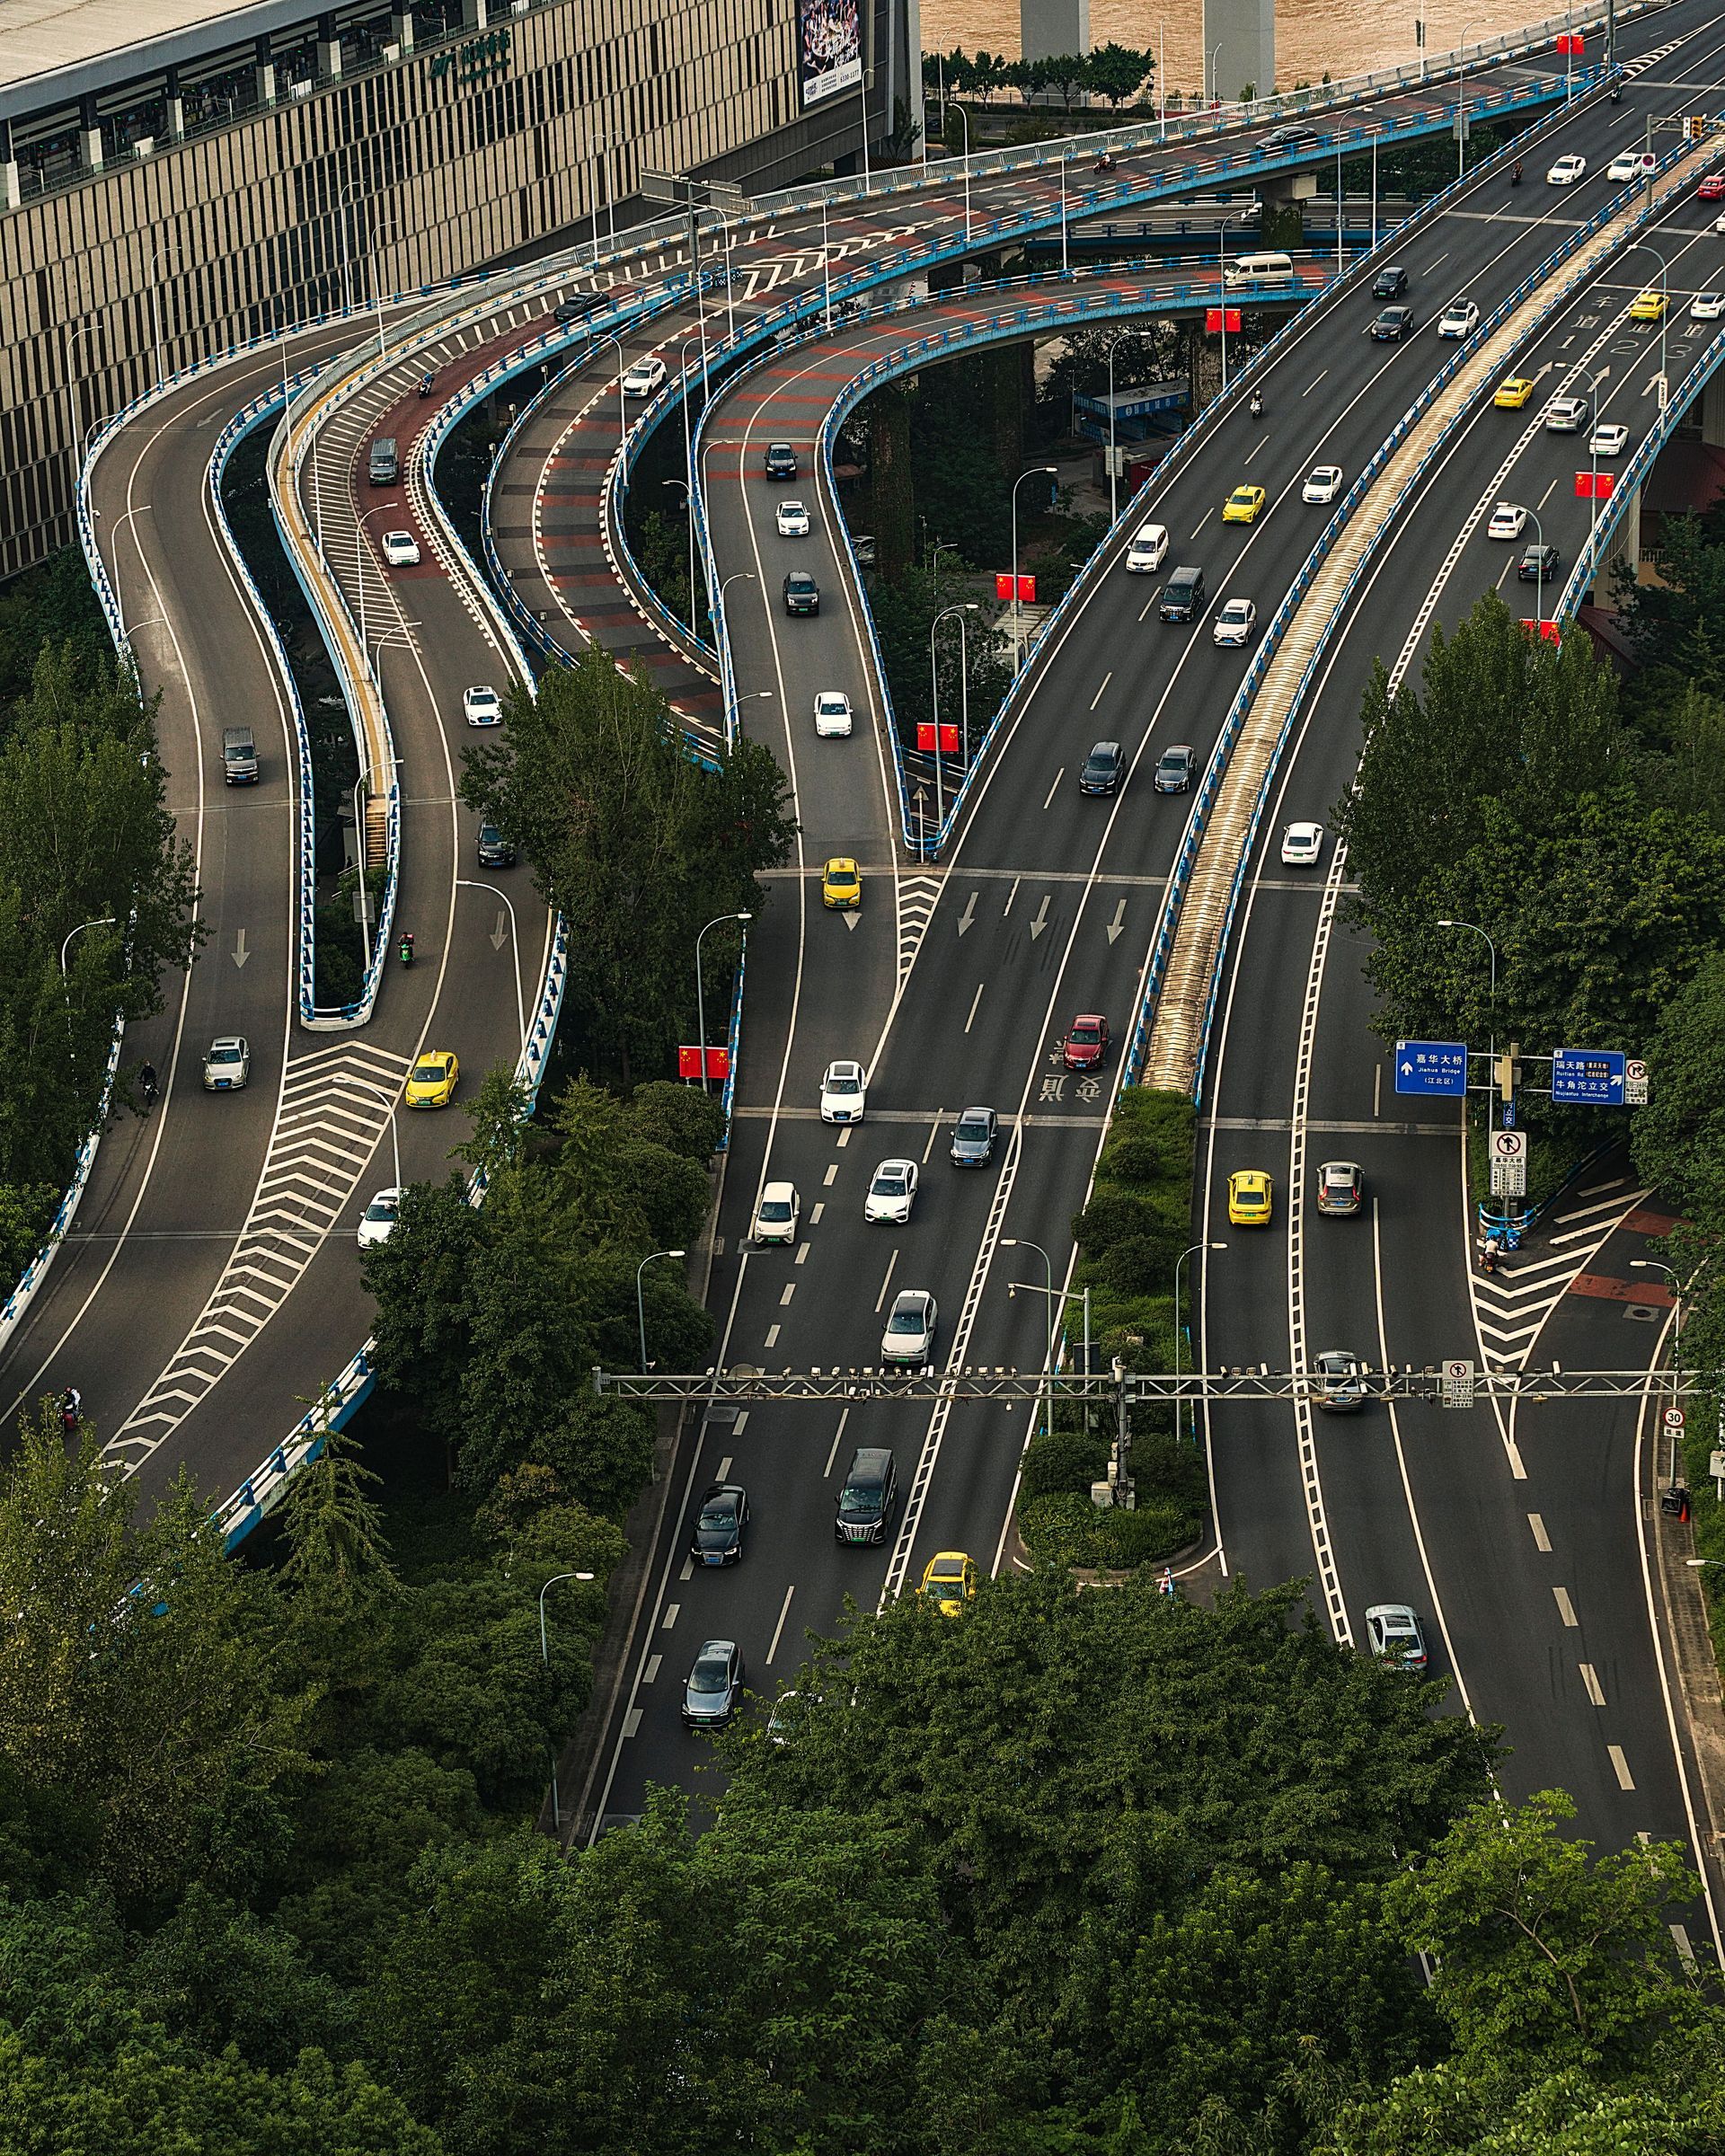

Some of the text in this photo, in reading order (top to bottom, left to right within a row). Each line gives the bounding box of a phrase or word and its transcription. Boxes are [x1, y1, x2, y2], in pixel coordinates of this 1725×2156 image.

[1416, 1054, 1463, 1065] 嘉华大桥
[1556, 1060, 1585, 1070] 瑞天路
[1556, 1080, 1608, 1091] 牛角沱立交
[1668, 1412, 1681, 1423] 30
